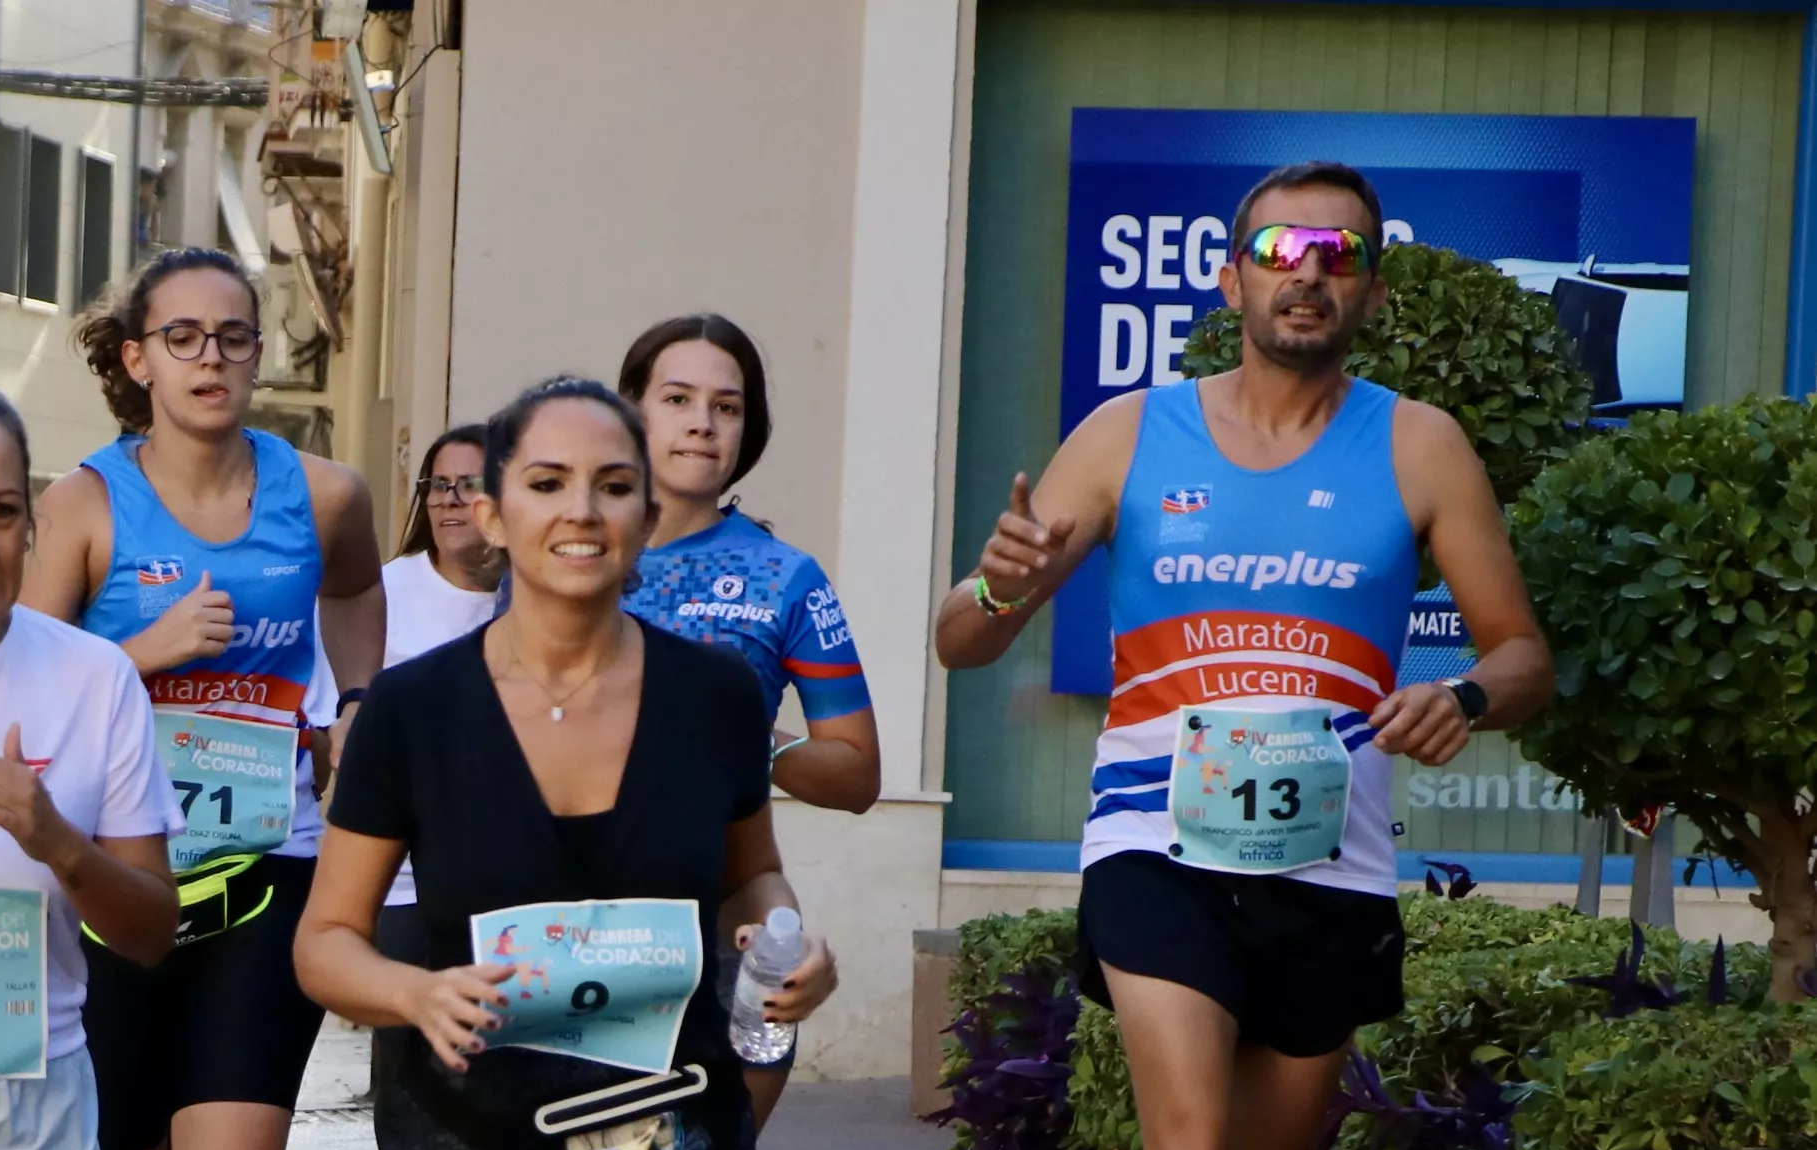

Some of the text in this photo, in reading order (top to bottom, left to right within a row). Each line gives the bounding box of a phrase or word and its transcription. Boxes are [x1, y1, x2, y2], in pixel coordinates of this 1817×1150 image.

[1098, 303, 1193, 387] DE
[1153, 551, 1362, 591] enerplus
[678, 601, 776, 623] enerplus
[1182, 617, 1330, 656] Maratón
[1197, 667, 1318, 698] Lucena
[1251, 731, 1268, 747] IV
[172, 780, 233, 825] 71
[1232, 778, 1301, 822] 13
[1407, 767, 1584, 810] santa
[190, 830, 210, 839] DIAZ
[1239, 848, 1284, 861] Infrico
[571, 927, 591, 944] IV
[590, 927, 654, 946] CARRERA
[571, 980, 610, 1014] 9
